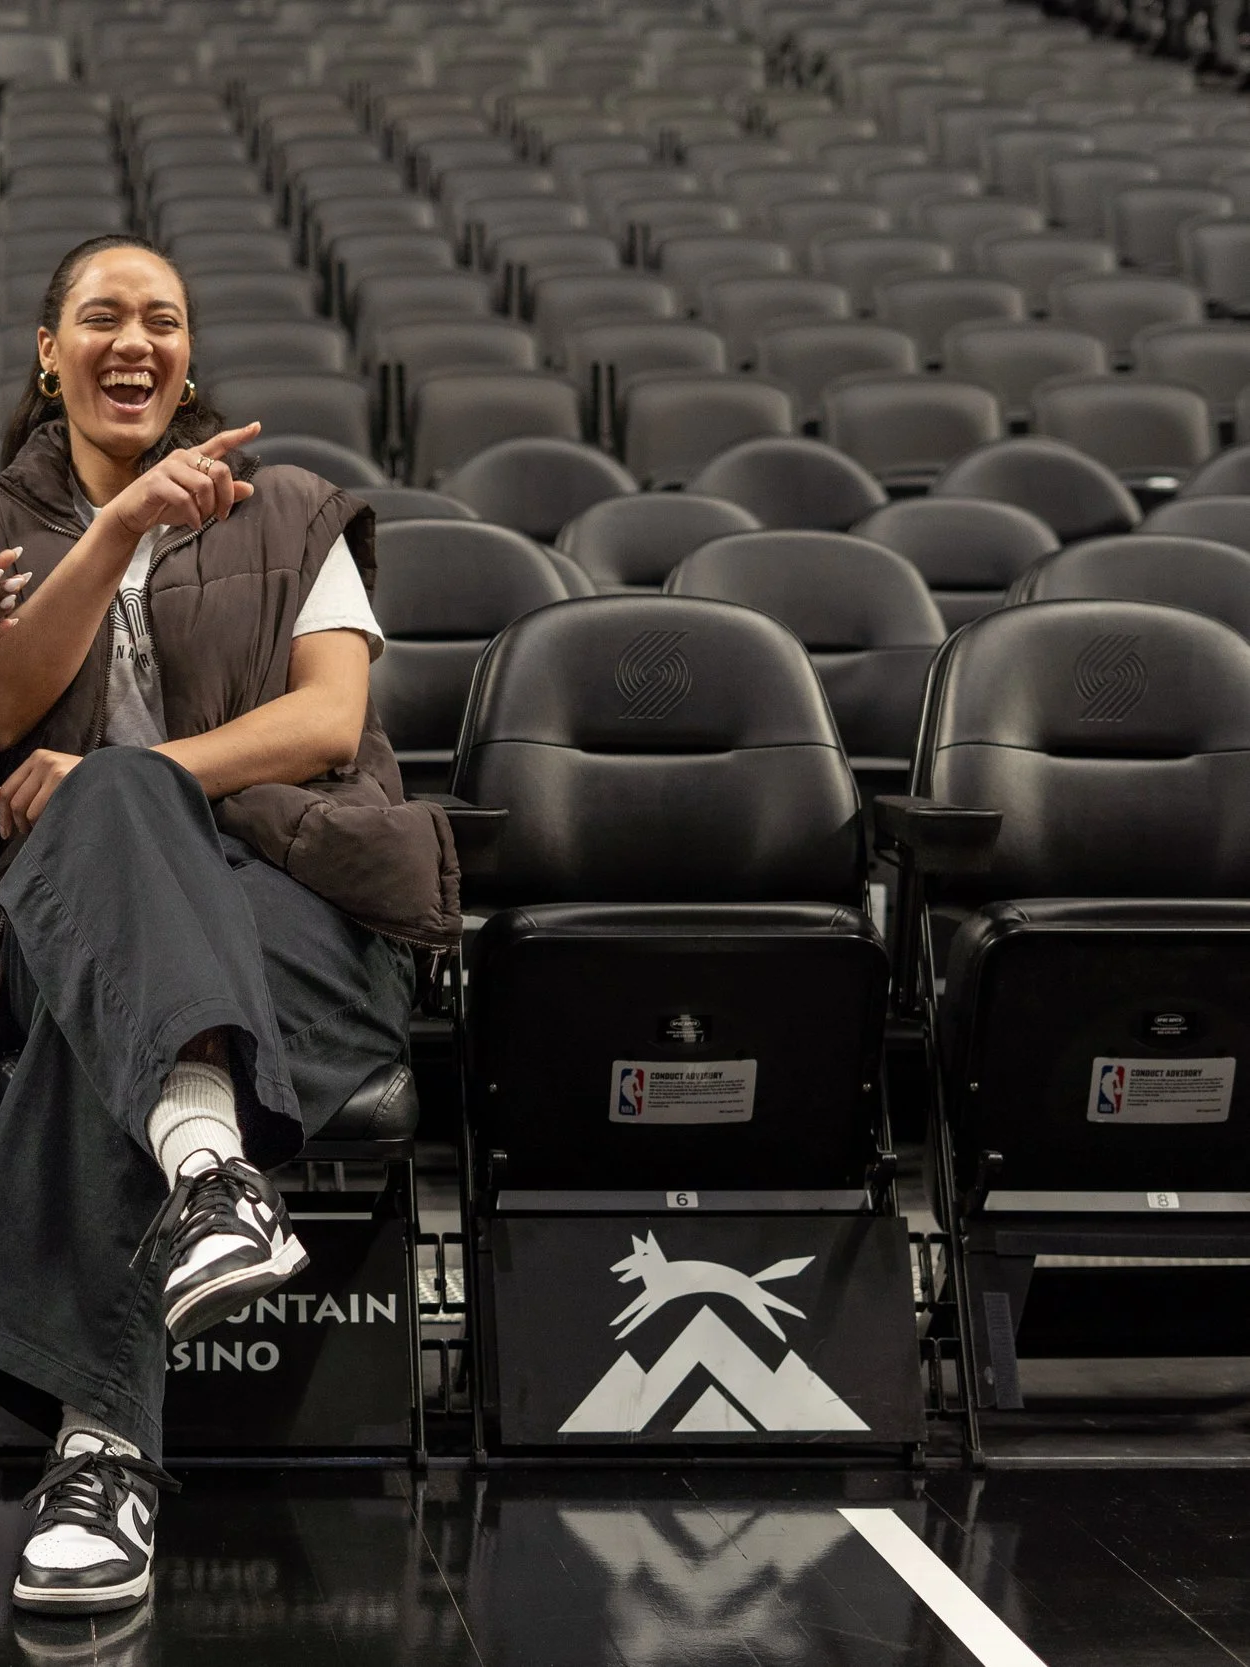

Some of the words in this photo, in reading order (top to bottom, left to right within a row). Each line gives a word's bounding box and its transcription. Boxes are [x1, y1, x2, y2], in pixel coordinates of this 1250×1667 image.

[650, 1072, 684, 1080] CONDUCT
[685, 1072, 724, 1080] ADVISORY
[1130, 1069, 1164, 1077] CONDUCT
[1165, 1069, 1203, 1077] ADVISORY
[621, 1105, 633, 1114] NBA
[676, 1193, 688, 1206] 6
[1157, 1194, 1169, 1207] 8
[165, 1341, 280, 1372] SINO
